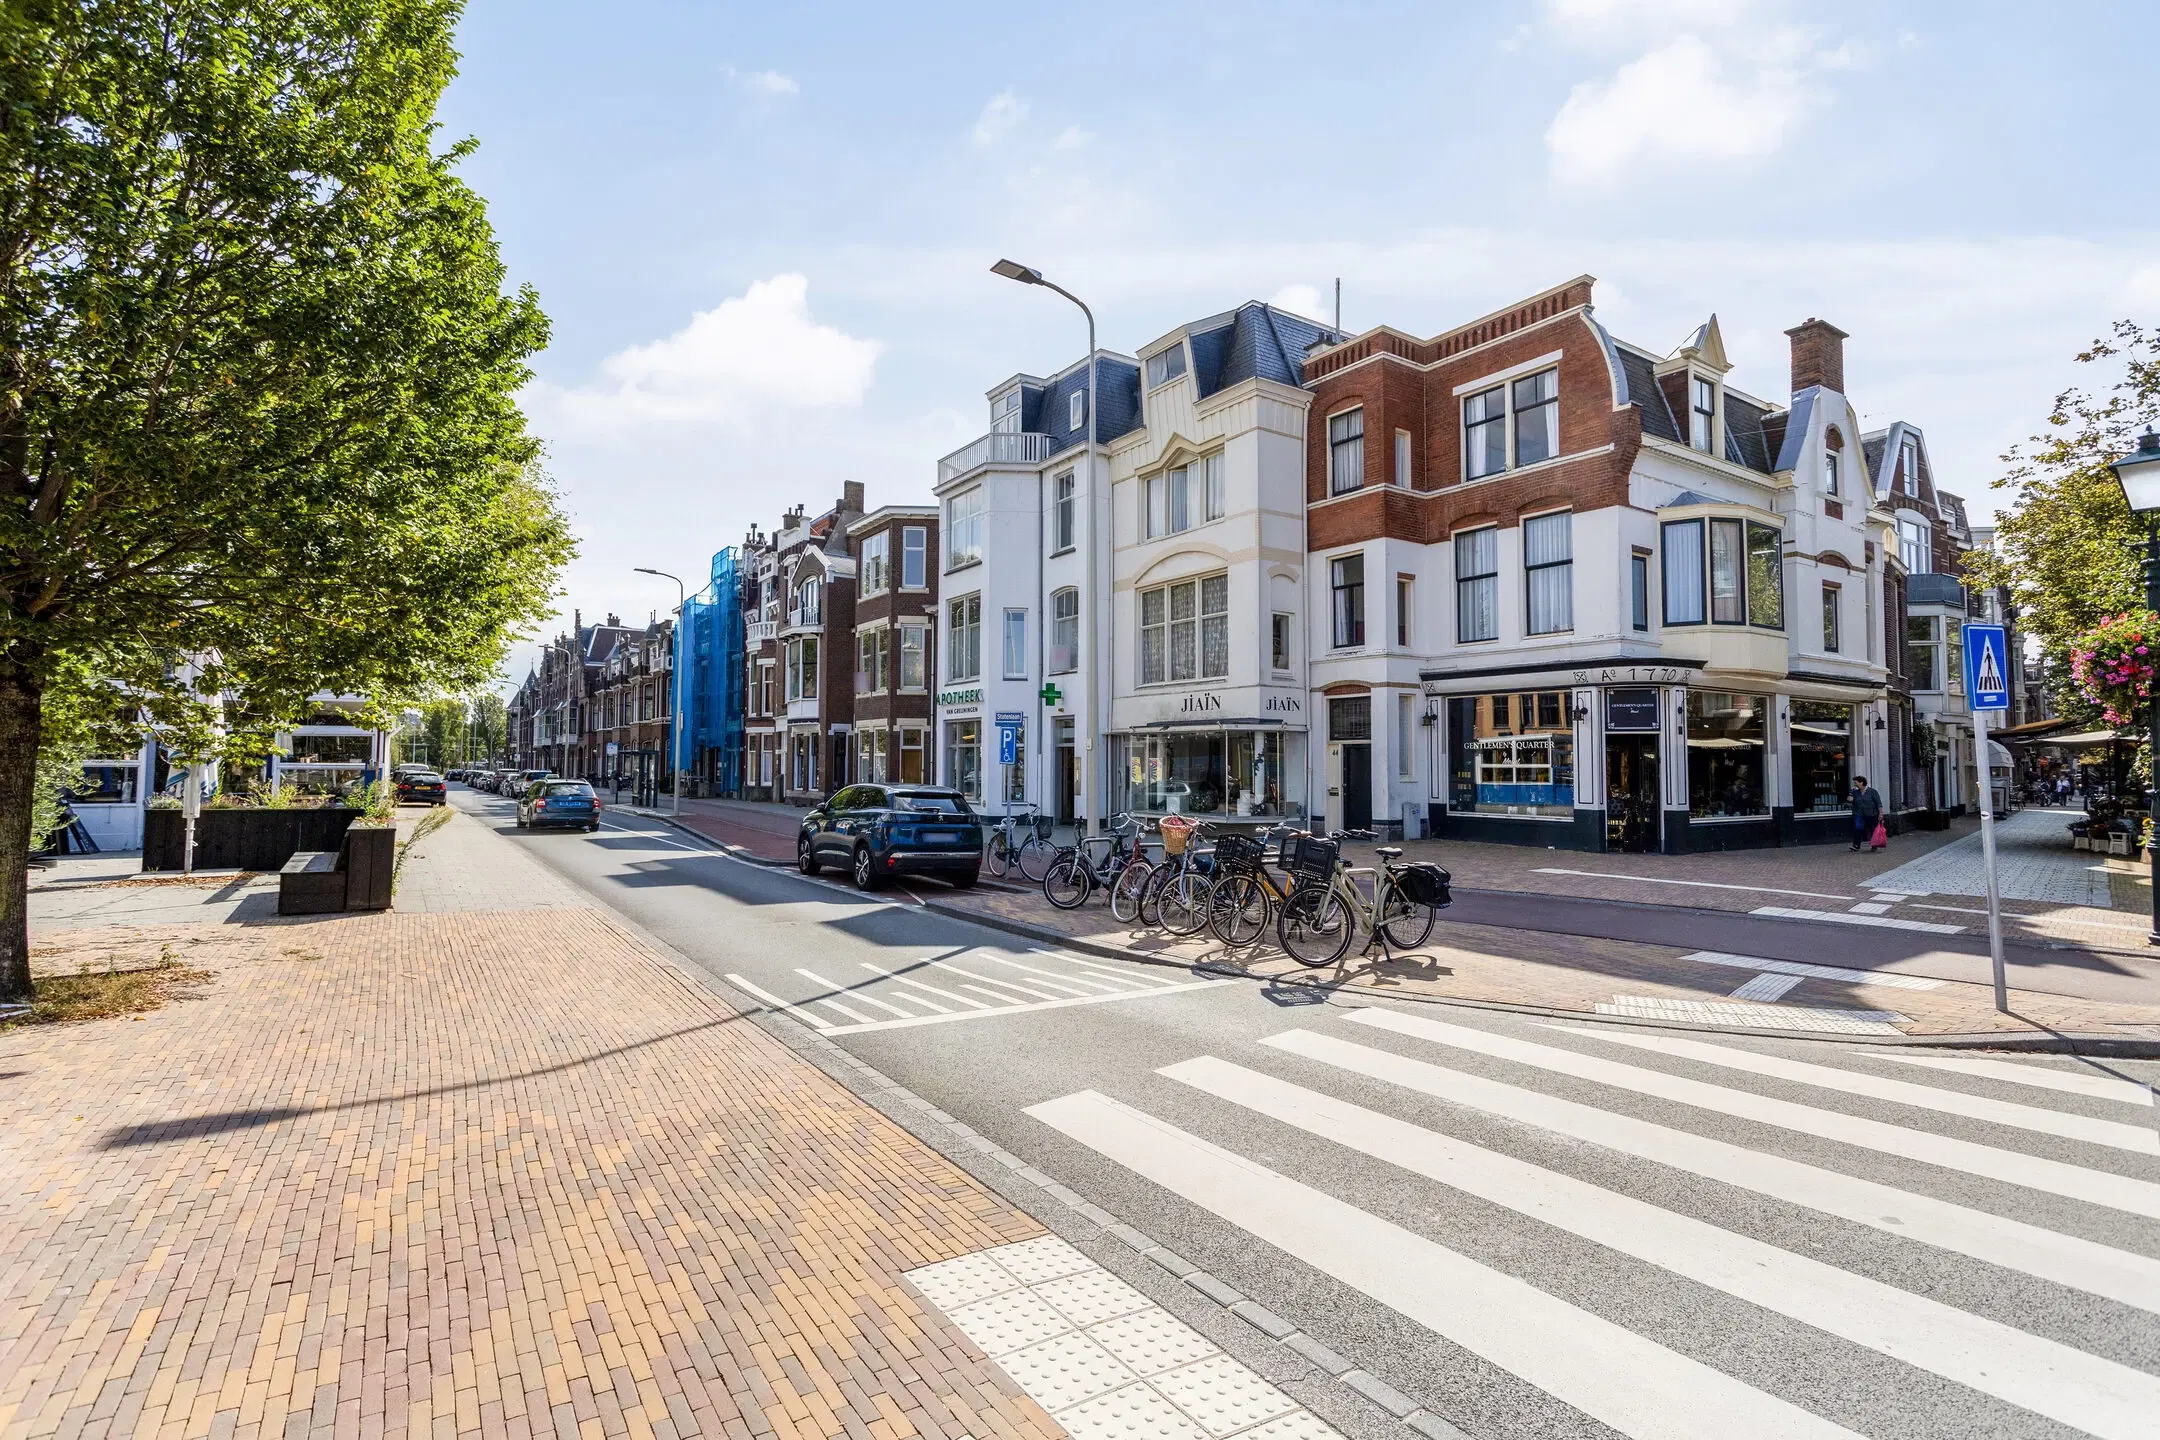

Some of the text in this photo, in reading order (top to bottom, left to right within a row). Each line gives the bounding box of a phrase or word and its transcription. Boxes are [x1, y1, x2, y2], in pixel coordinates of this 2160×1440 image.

[1628, 668, 1677, 681] 1770
[936, 689, 981, 706] APOTHEEK
[1003, 730, 1012, 748] P
[1516, 741, 1555, 750] QUARTER
